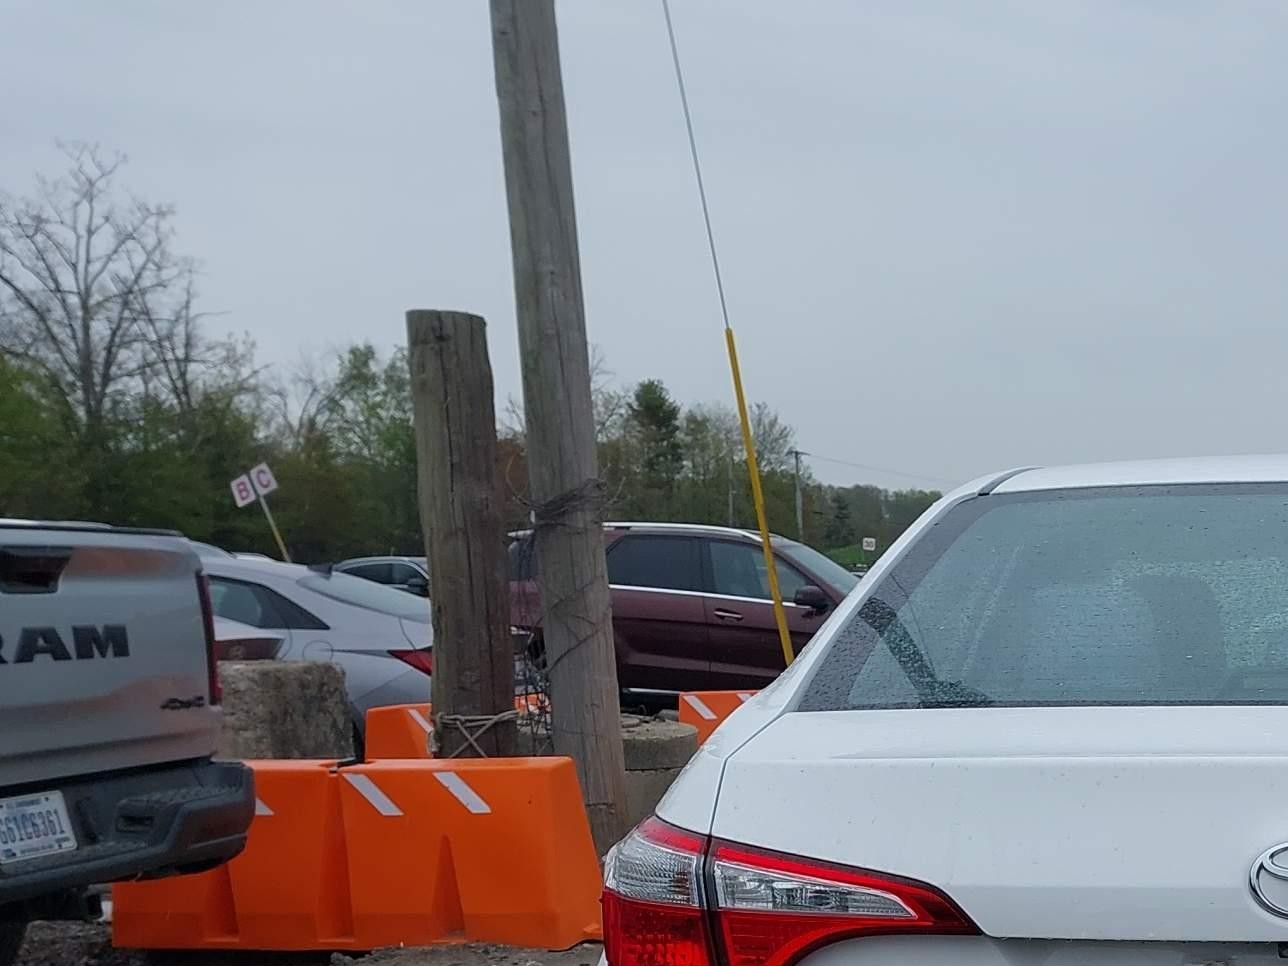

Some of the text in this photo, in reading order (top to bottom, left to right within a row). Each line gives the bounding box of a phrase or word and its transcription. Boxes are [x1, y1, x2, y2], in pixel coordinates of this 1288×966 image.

[236, 470, 271, 501] B C
[0, 624, 130, 664] AM
